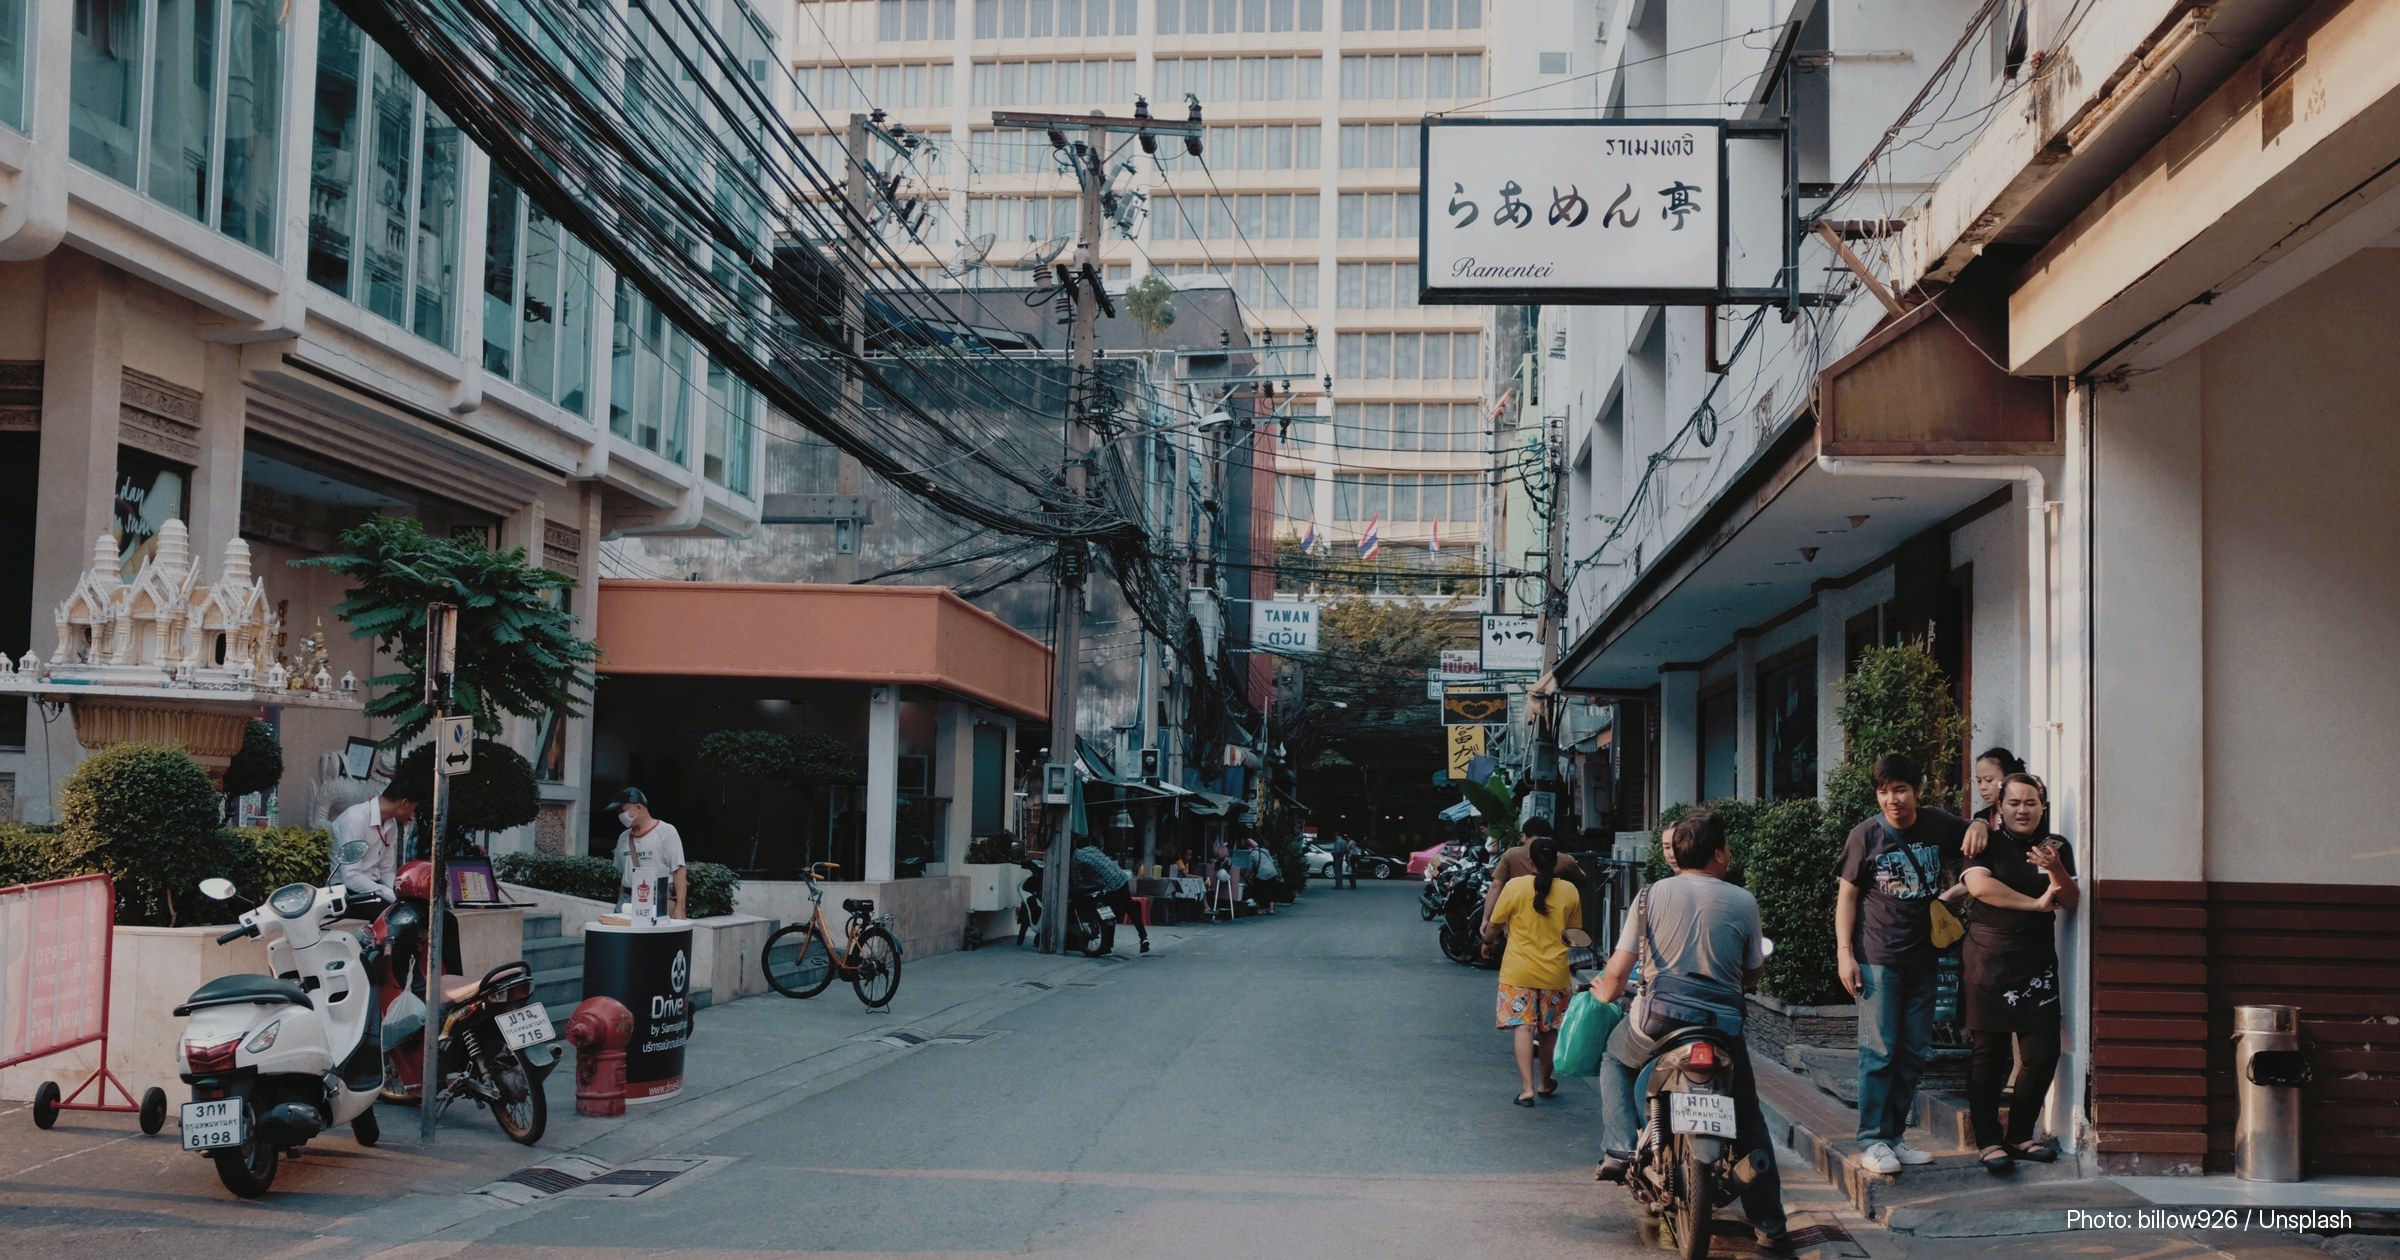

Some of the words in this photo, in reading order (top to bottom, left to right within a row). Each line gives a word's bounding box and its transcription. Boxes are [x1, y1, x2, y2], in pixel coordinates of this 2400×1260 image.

[1605, 133, 1694, 157] ราเมงเทอิ
[1448, 180, 1702, 232] らあめん亭
[1451, 256, 1554, 279] Ramentei
[1265, 609, 1309, 623] TAWAN
[1492, 631, 1534, 647] かつ
[651, 994, 683, 1019] Drive
[651, 1024, 660, 1037] by
[196, 1103, 226, 1118] 3กท
[185, 1118, 238, 1133] กรุงเทพมหานคร
[1688, 1119, 1721, 1132] 716
[191, 1131, 231, 1146] 6198
